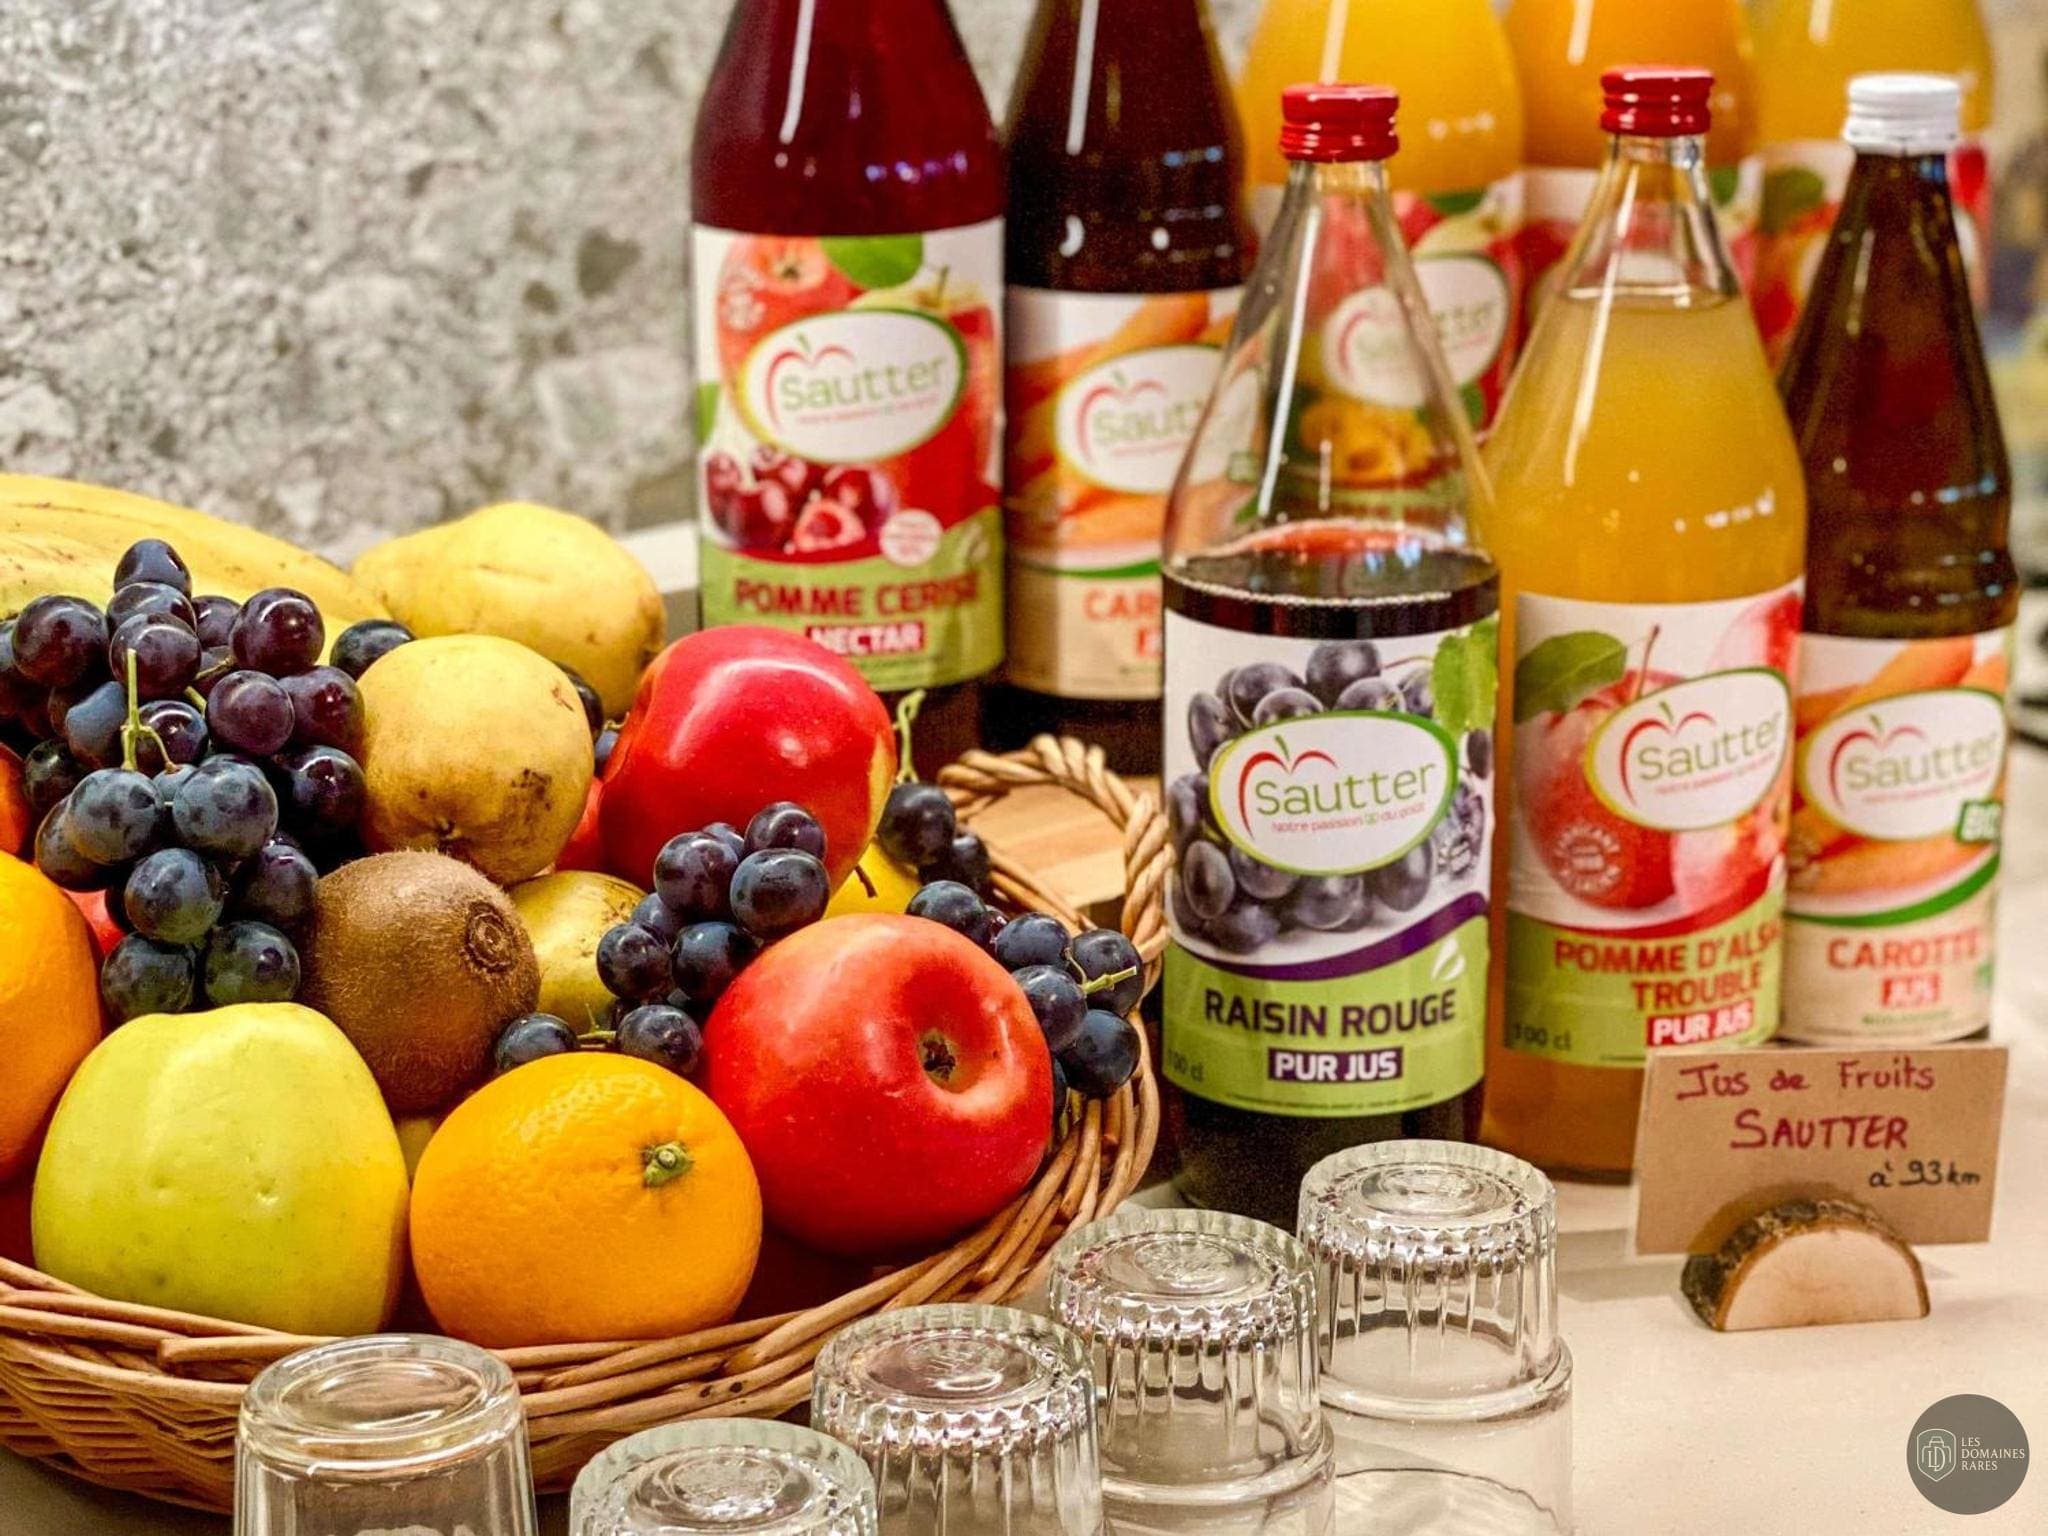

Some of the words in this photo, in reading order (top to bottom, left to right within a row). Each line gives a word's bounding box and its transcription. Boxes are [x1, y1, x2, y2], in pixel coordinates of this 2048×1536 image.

[780, 355, 946, 411] Sautter
[735, 578, 863, 617] POMME
[1082, 588, 1161, 623] CAR
[1637, 711, 1784, 782] Sautter
[1846, 732, 1999, 790] Sautter
[1254, 762, 1436, 816] Sautter
[1554, 939, 1687, 974] POMME
[1631, 960, 1762, 1012] TROUBLE
[1204, 987, 1328, 1037] RAISIN
[1340, 988, 1457, 1038] ROUGE
[1652, 1016, 1711, 1046] PUR
[1274, 1051, 1337, 1081] PUR
[1343, 1050, 1398, 1082] JUS
[1675, 1062, 1750, 1101] Jus
[1769, 1069, 1810, 1091] de
[1837, 1055, 1936, 1091] Fruits
[1729, 1107, 1910, 1150] SAUTTER
[1868, 1160, 1895, 1188] à
